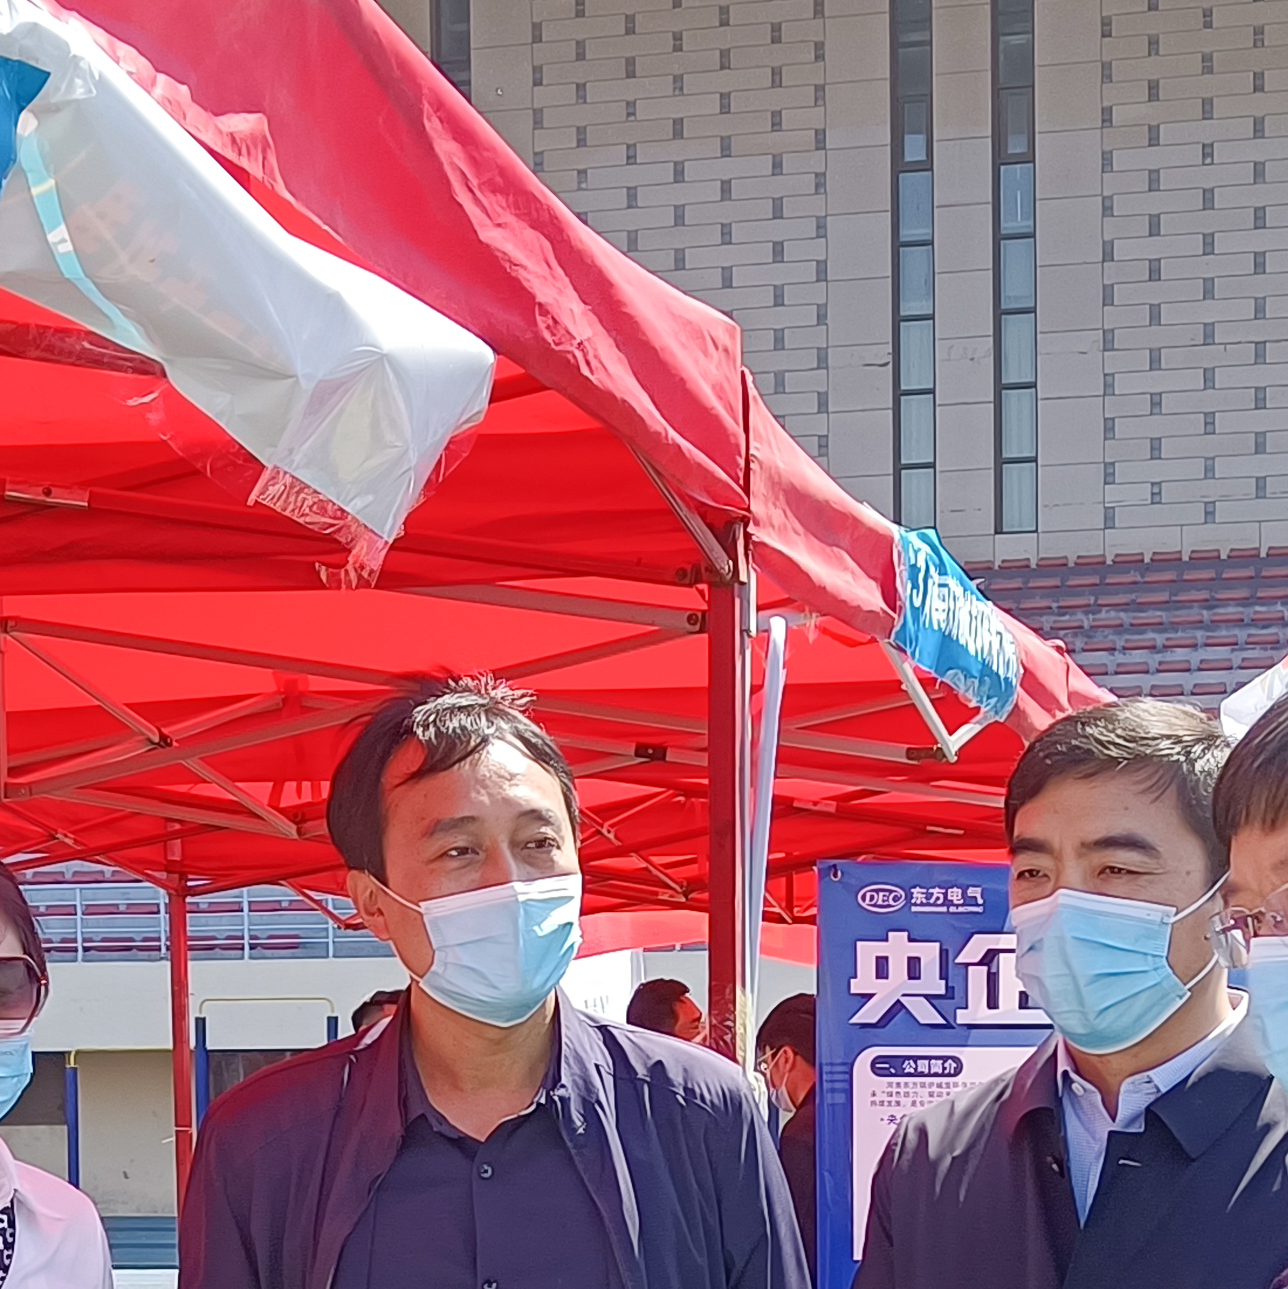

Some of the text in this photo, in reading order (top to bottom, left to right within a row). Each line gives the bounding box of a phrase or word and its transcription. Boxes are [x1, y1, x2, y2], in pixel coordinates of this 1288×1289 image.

[864, 891, 901, 906] DEC
[910, 886, 984, 905] 东方电气
[875, 1059, 957, 1075] 一、公司简介
